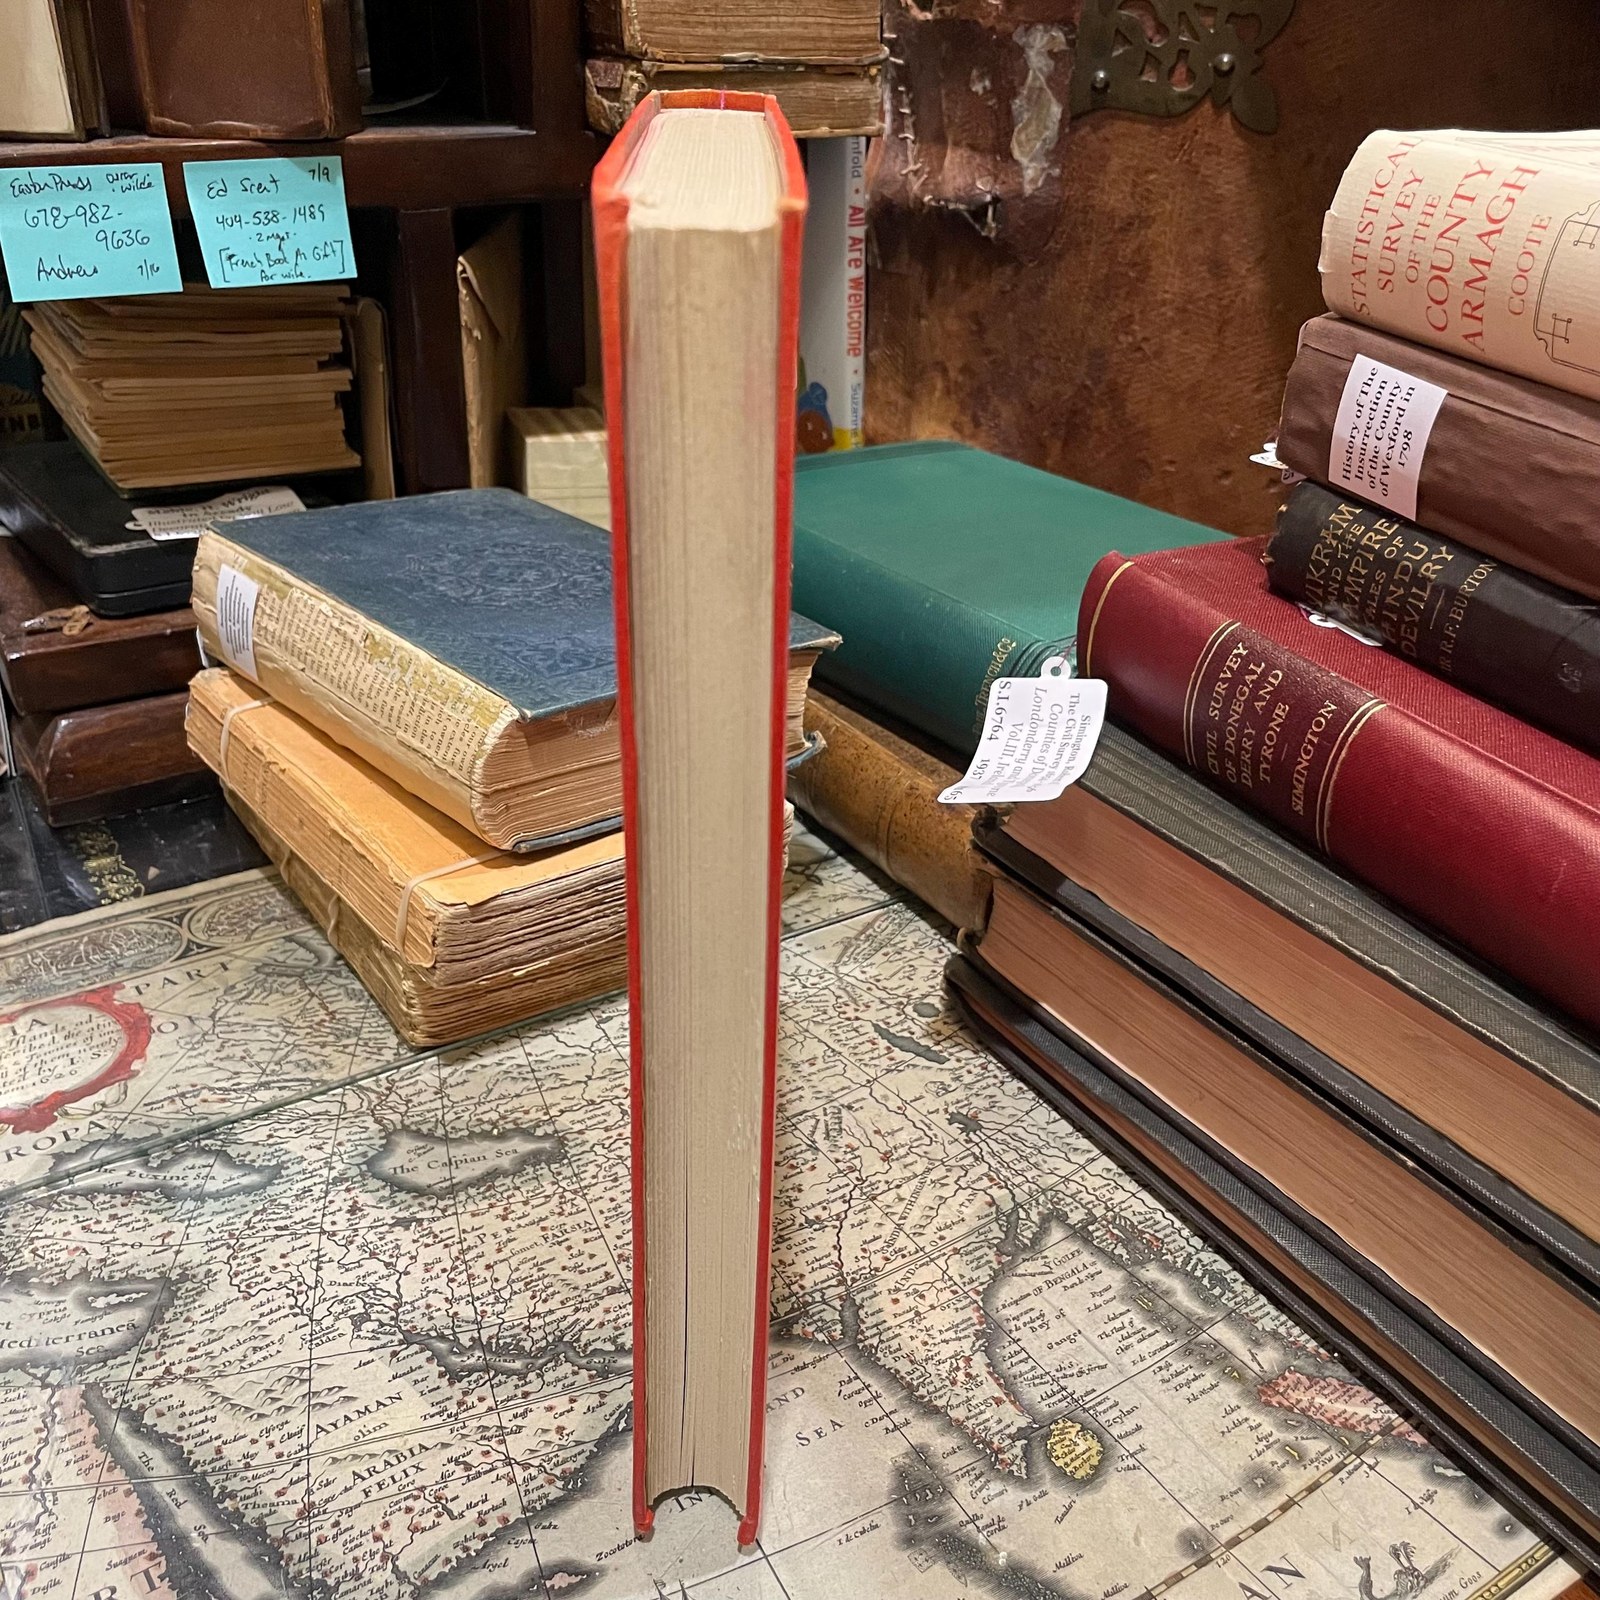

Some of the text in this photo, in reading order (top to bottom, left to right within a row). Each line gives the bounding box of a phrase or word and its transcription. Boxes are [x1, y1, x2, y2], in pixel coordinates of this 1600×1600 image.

[207, 178, 227, 199] Ed
[308, 162, 331, 182] 7/9
[96, 229, 150, 251] 9636
[847, 205, 865, 227] All
[1351, 137, 1424, 316] STATISTICAL
[1377, 169, 1424, 293] SURVEY
[1405, 194, 1442, 283] OF THE
[1425, 159, 1496, 333] COUNTY
[847, 236, 862, 269] Are
[1460, 165, 1542, 353] ARMAGH
[1507, 213, 1553, 316] COOTE
[1342, 367, 1379, 481] History of The
[1354, 379, 1388, 481] Insurrection
[1368, 381, 1402, 489] of the County
[1380, 385, 1415, 497] of Wexford in
[1397, 429, 1413, 469] 1798
[1305, 503, 1363, 608] VIKRAM
[1338, 522, 1366, 558] THE
[1384, 536, 1405, 559] OF
[1382, 540, 1430, 642] HINDU
[1402, 545, 1455, 657] DEVILRY
[1450, 559, 1498, 623] BURTON
[986, 680, 1012, 741] S.I.6764
[1068, 693, 1080, 715] The
[1206, 641, 1249, 775] CIVIL SURVEY
[1224, 661, 1265, 783] OF DONEGAL
[1254, 669, 1283, 715] AND
[1017, 687, 1047, 765] Londonderry
[1044, 703, 1064, 755] Counties
[1064, 717, 1077, 740] Civil
[1259, 702, 1290, 784] TYRONE
[1291, 699, 1338, 816] SIMINGTON
[389, 1165, 419, 1175] The
[495, 1147, 519, 1158] Sea
[315, 1391, 404, 1440] AYAMAN
[353, 1421, 390, 1442] olim
[796, 1418, 846, 1447] SEA
[351, 1442, 432, 1486] ARABIA
[361, 1460, 427, 1499] FELIX
